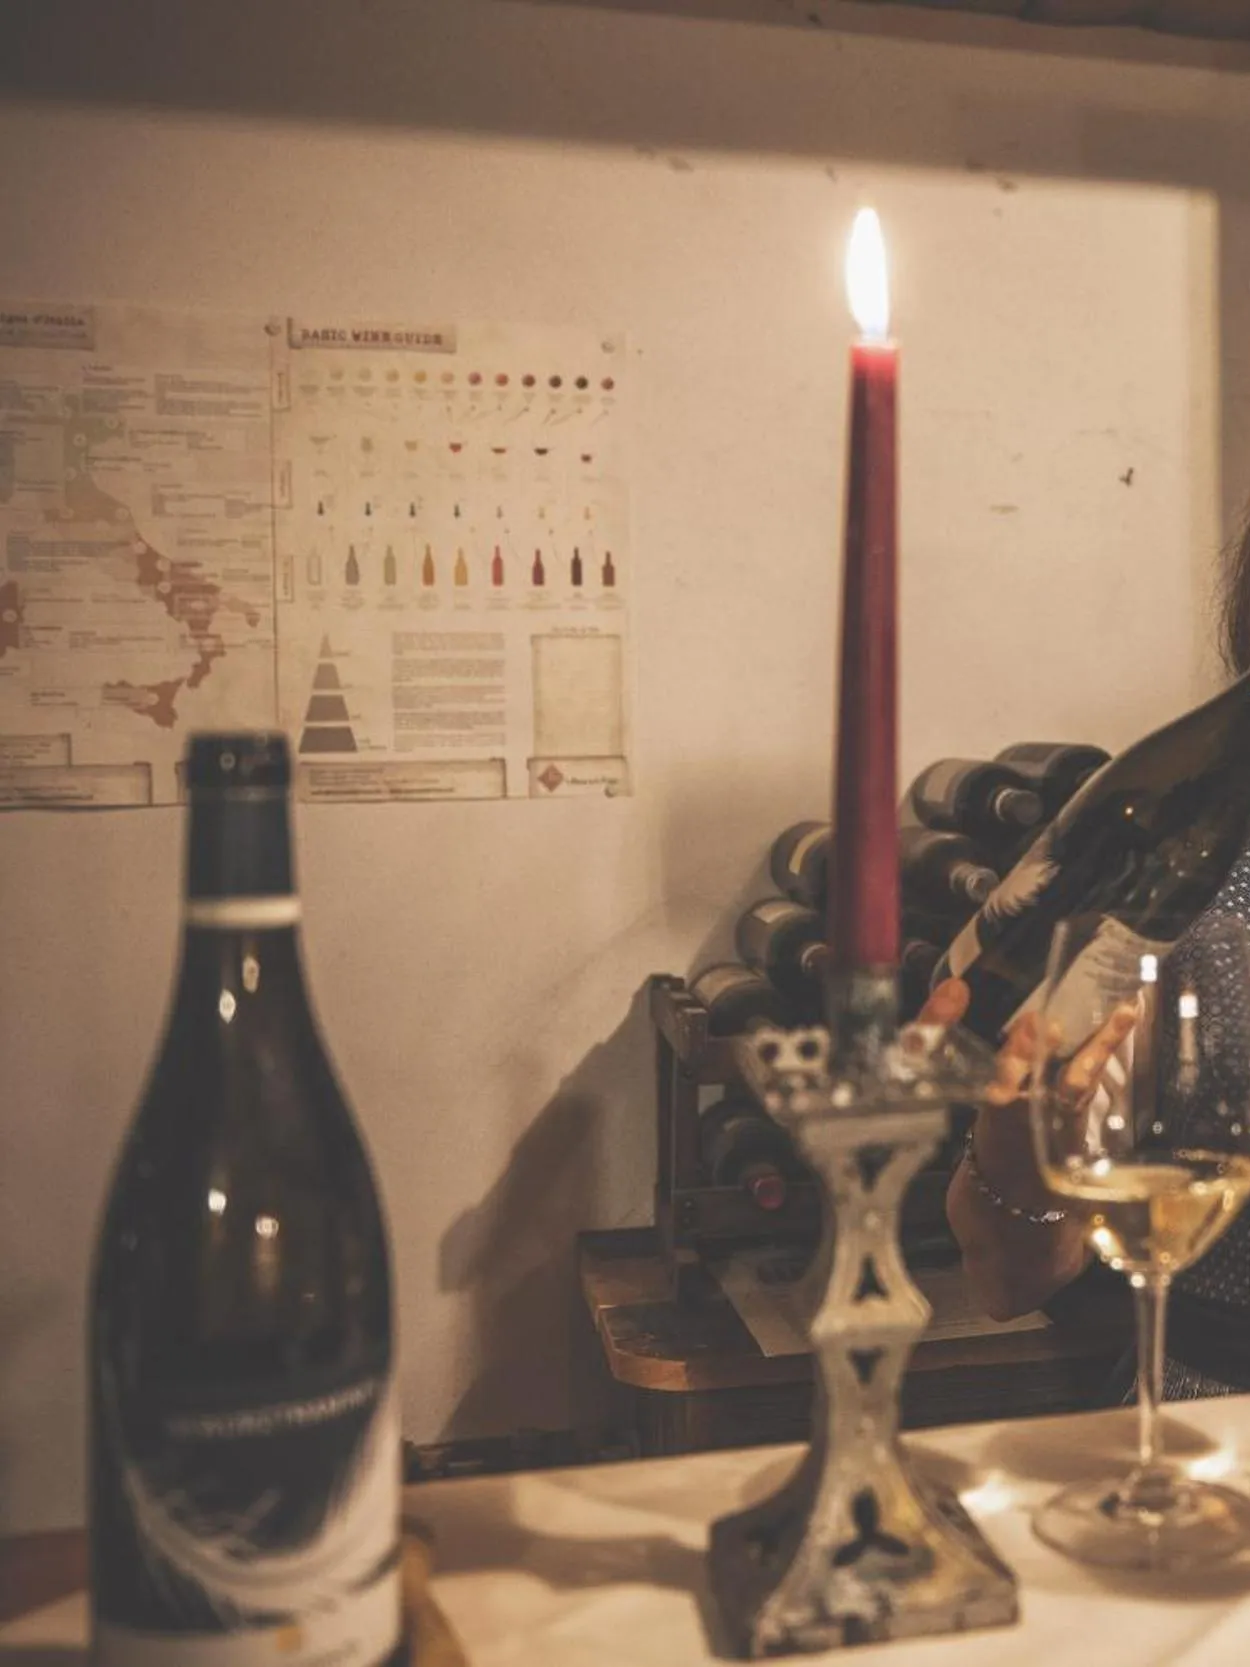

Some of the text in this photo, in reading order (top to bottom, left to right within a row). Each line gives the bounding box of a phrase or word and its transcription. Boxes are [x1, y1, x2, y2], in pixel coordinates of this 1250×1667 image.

[301, 328, 443, 346] BASIC WINE GUIDE
